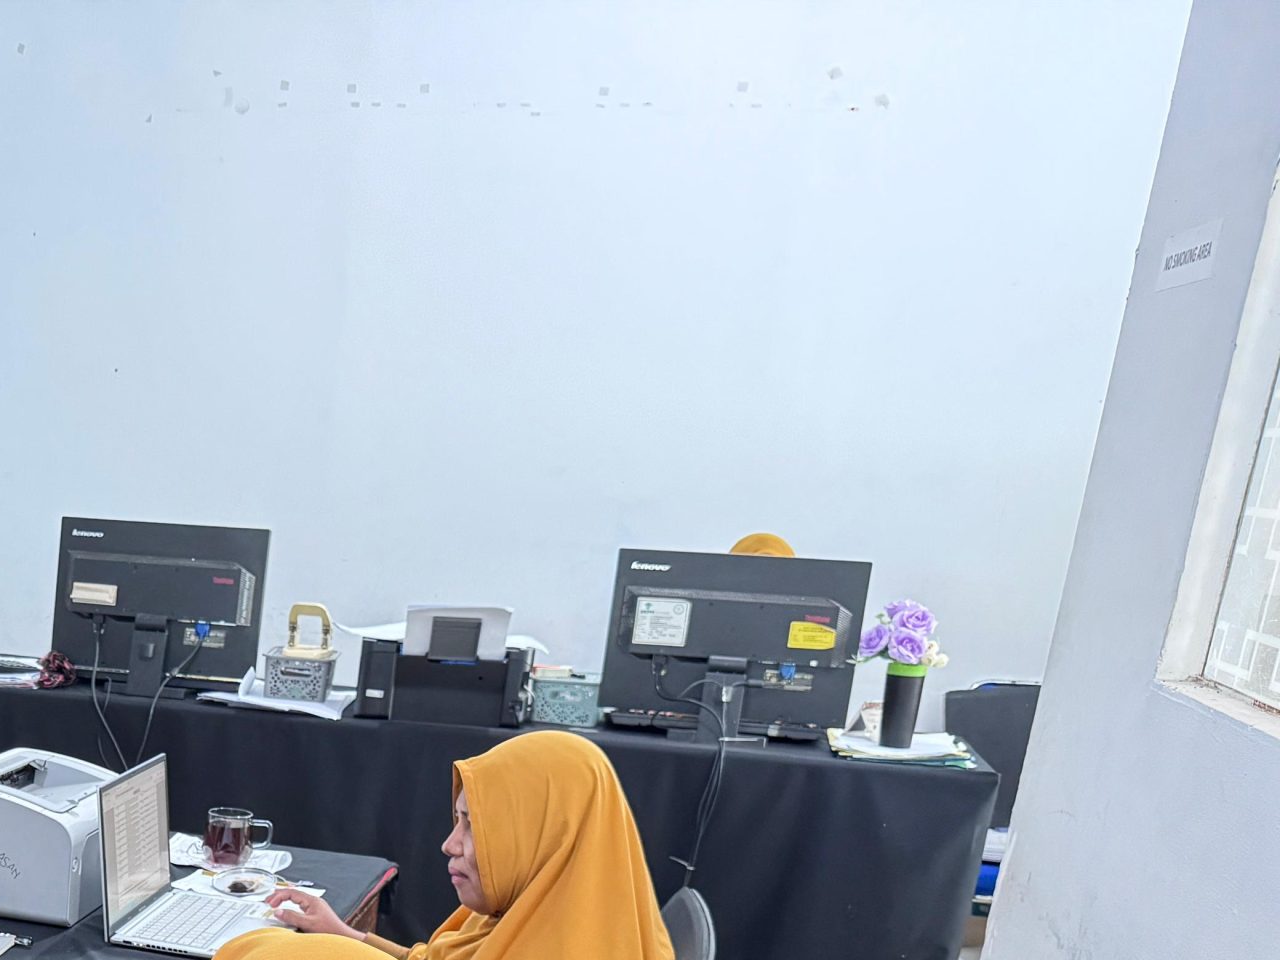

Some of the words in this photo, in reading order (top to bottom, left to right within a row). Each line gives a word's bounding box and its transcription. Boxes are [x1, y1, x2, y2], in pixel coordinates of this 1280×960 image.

[1162, 255, 1174, 271] NO
[1172, 246, 1198, 268] SMOKING
[1196, 241, 1212, 261] AREA
[630, 560, 671, 571] lenovo
